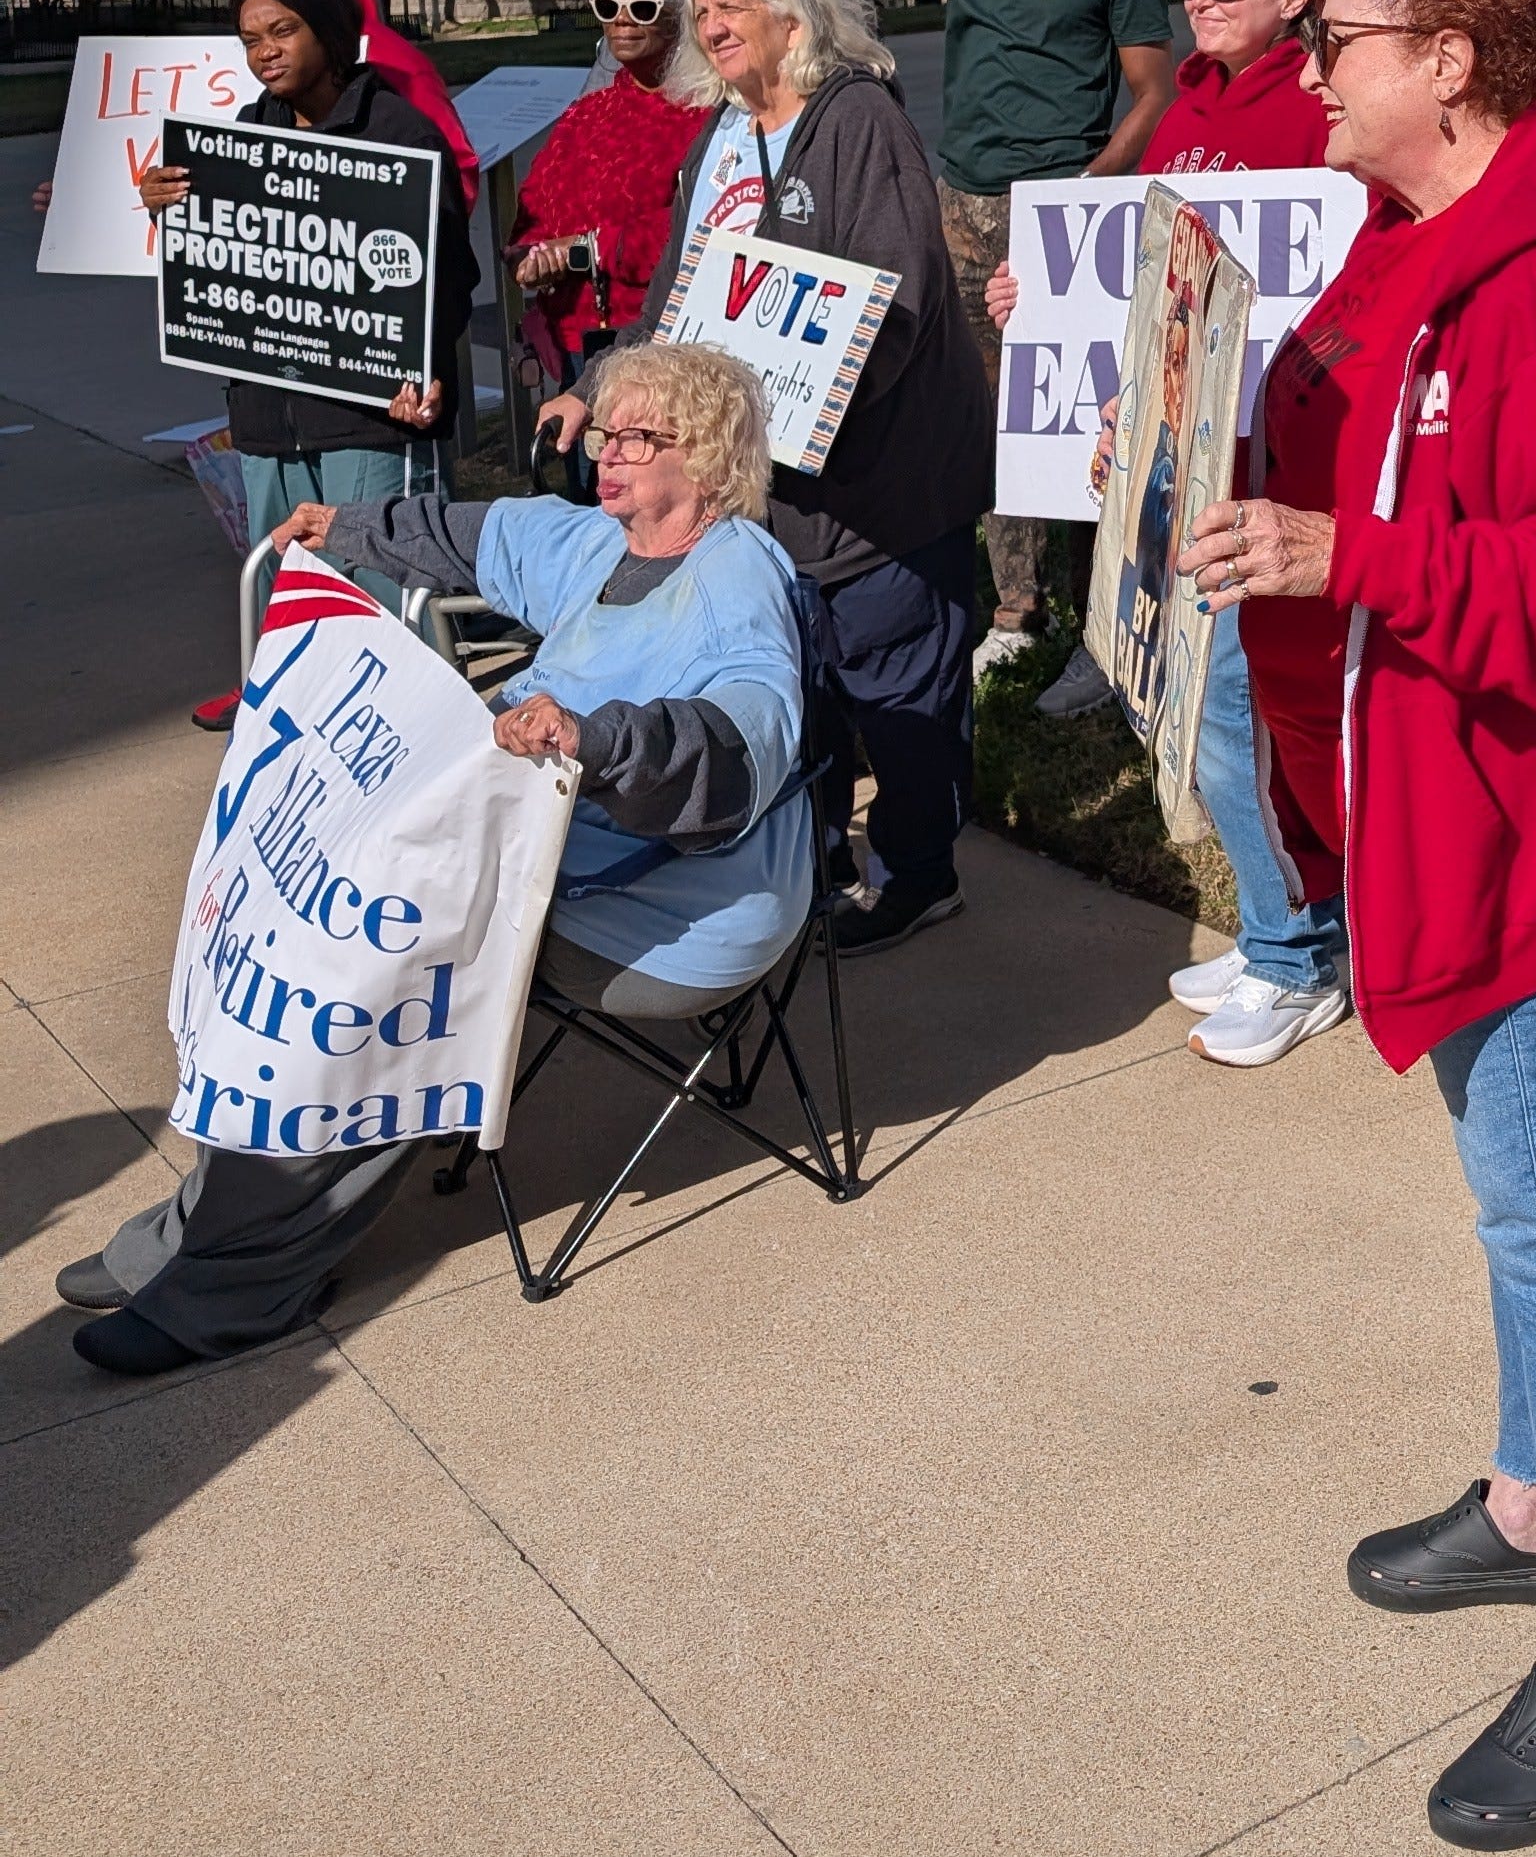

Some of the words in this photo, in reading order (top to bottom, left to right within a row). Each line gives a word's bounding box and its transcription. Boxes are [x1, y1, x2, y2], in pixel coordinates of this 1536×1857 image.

[98, 51, 238, 119] LET'S
[185, 128, 265, 168] Voting
[271, 142, 408, 185] Problems?
[264, 171, 320, 202] Call:
[165, 193, 357, 259] ELECTION
[372, 234, 397, 247] 866
[165, 229, 355, 295] PROTECTION
[369, 247, 410, 266] OUR
[378, 267, 412, 280] VOTE
[183, 278, 404, 342] 1-866-OUR-VOTE
[186, 311, 224, 329] Spanish
[725, 252, 846, 345] VOTE
[252, 341, 332, 367] 888-API-VOTE
[254, 325, 279, 342] Asian
[280, 330, 330, 350] Languages
[364, 346, 397, 362] Arabic
[338, 356, 423, 383] 844-YALLA-US
[1132, 584, 1157, 643] BY
[313, 647, 410, 797] Texas
[249, 752, 422, 954] Alliance
